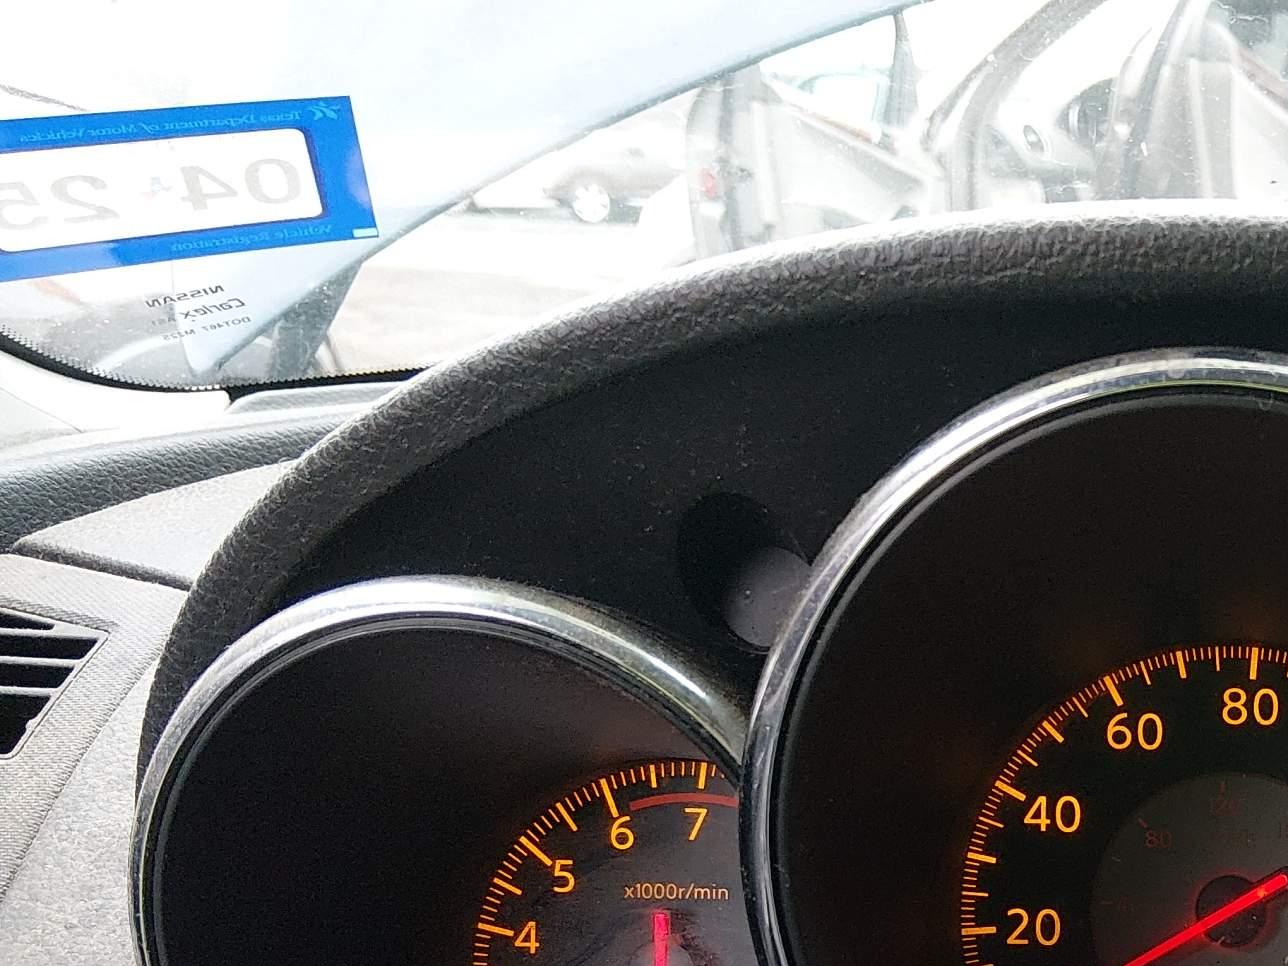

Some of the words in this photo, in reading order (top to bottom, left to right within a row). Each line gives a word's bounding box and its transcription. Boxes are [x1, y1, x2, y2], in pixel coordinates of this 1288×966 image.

[1221, 688, 1279, 725] 80
[1106, 712, 1163, 750] 60
[684, 808, 708, 841] 7
[1023, 796, 1081, 833] 40
[610, 816, 634, 850] 6
[553, 859, 574, 893] 5
[623, 883, 729, 901] x1000r/min
[515, 921, 540, 954] 4
[1006, 908, 1061, 945] 20
